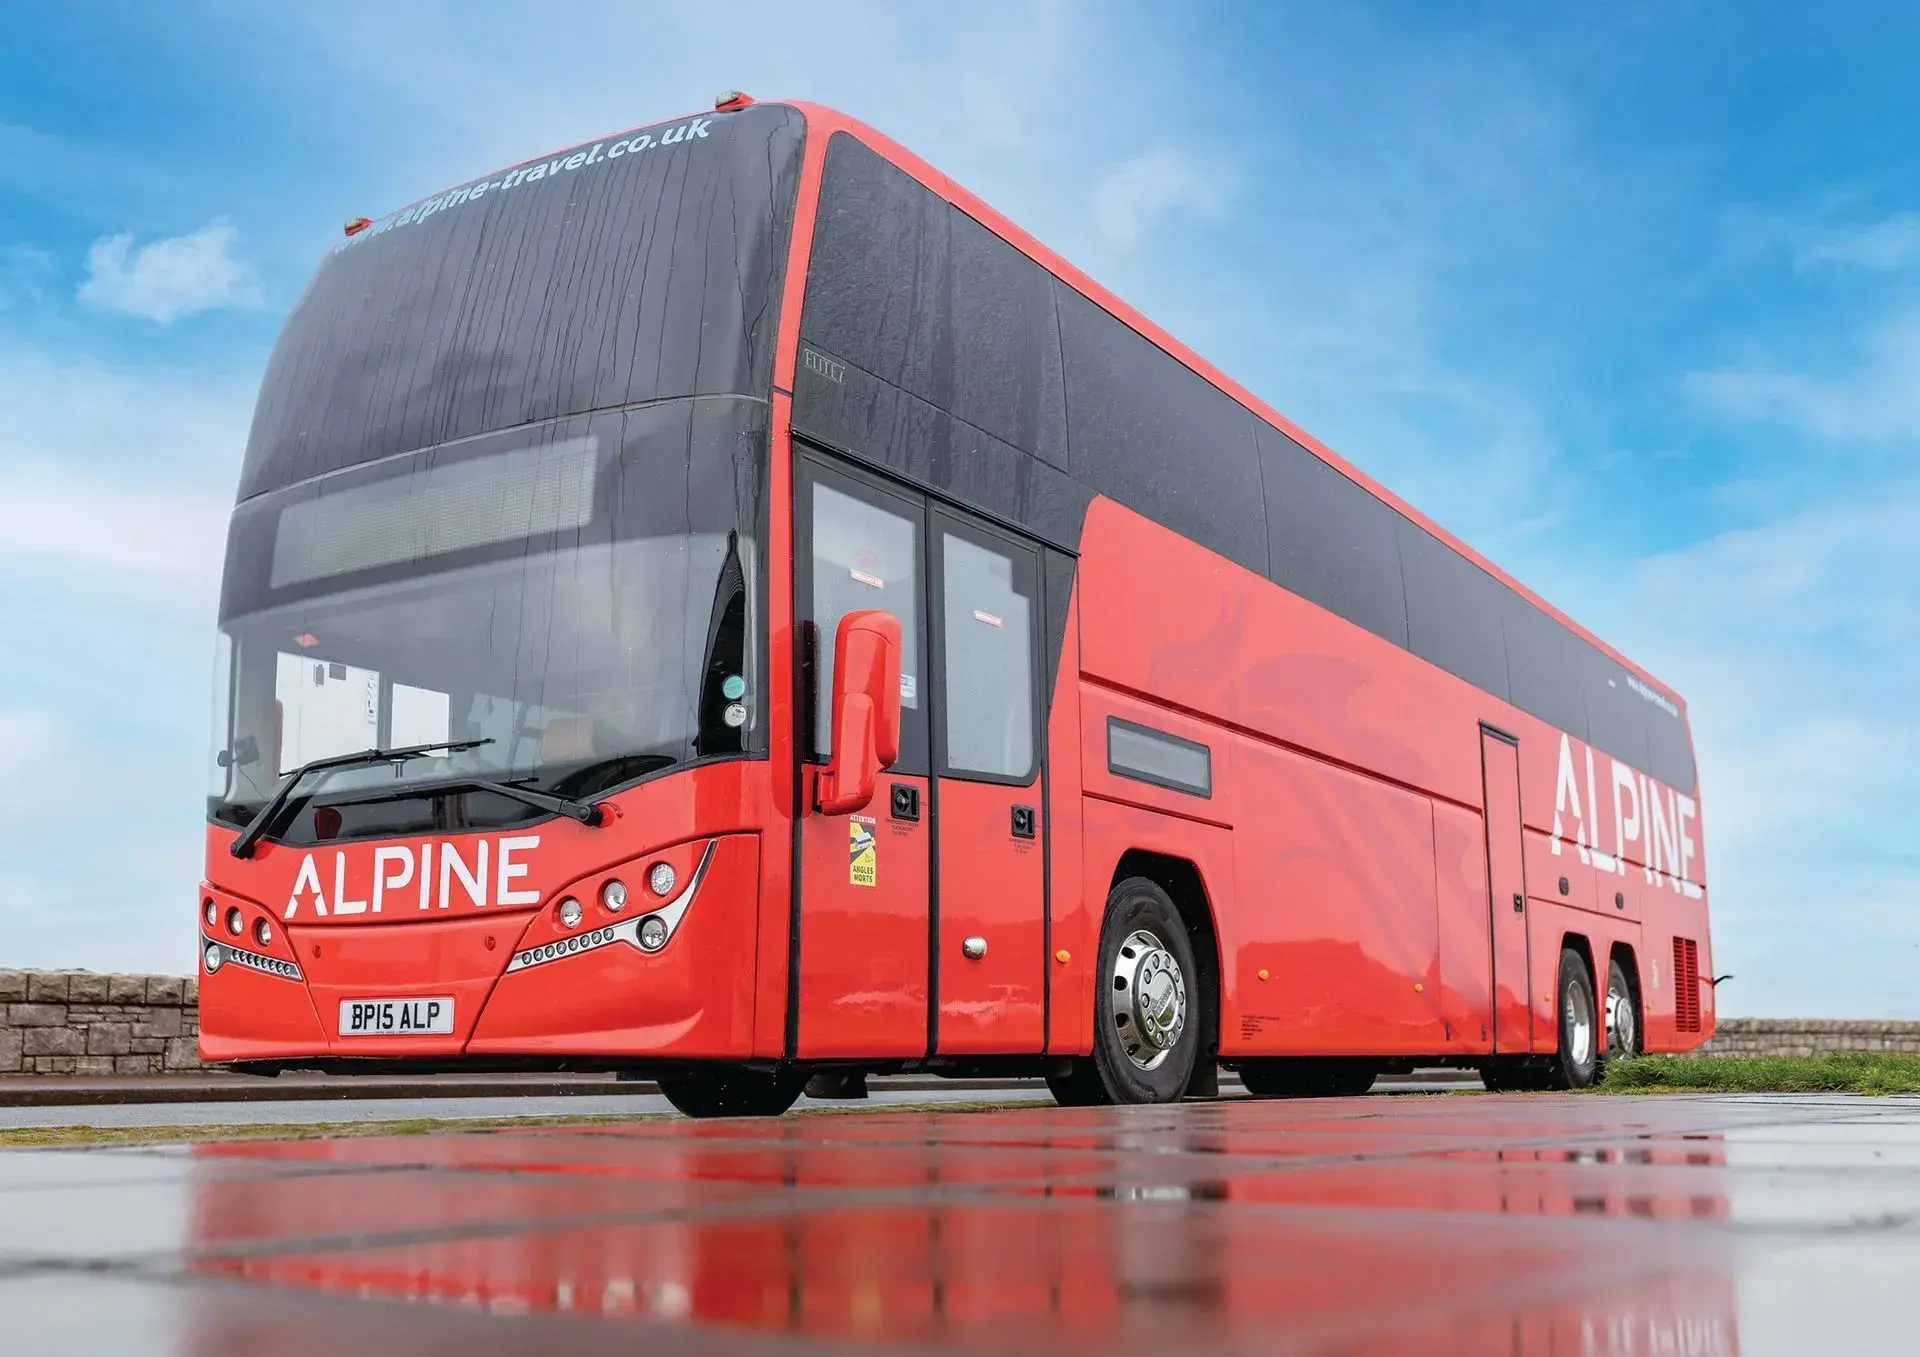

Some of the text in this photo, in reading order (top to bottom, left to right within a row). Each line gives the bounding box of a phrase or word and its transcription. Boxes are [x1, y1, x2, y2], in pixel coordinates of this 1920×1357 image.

[1551, 733, 1703, 899] ALPINE
[283, 835, 541, 919] ALPINE
[853, 865, 874, 875] ANGLES
[853, 874, 873, 883] MORTS
[351, 1001, 440, 1030] BP15 ALP
